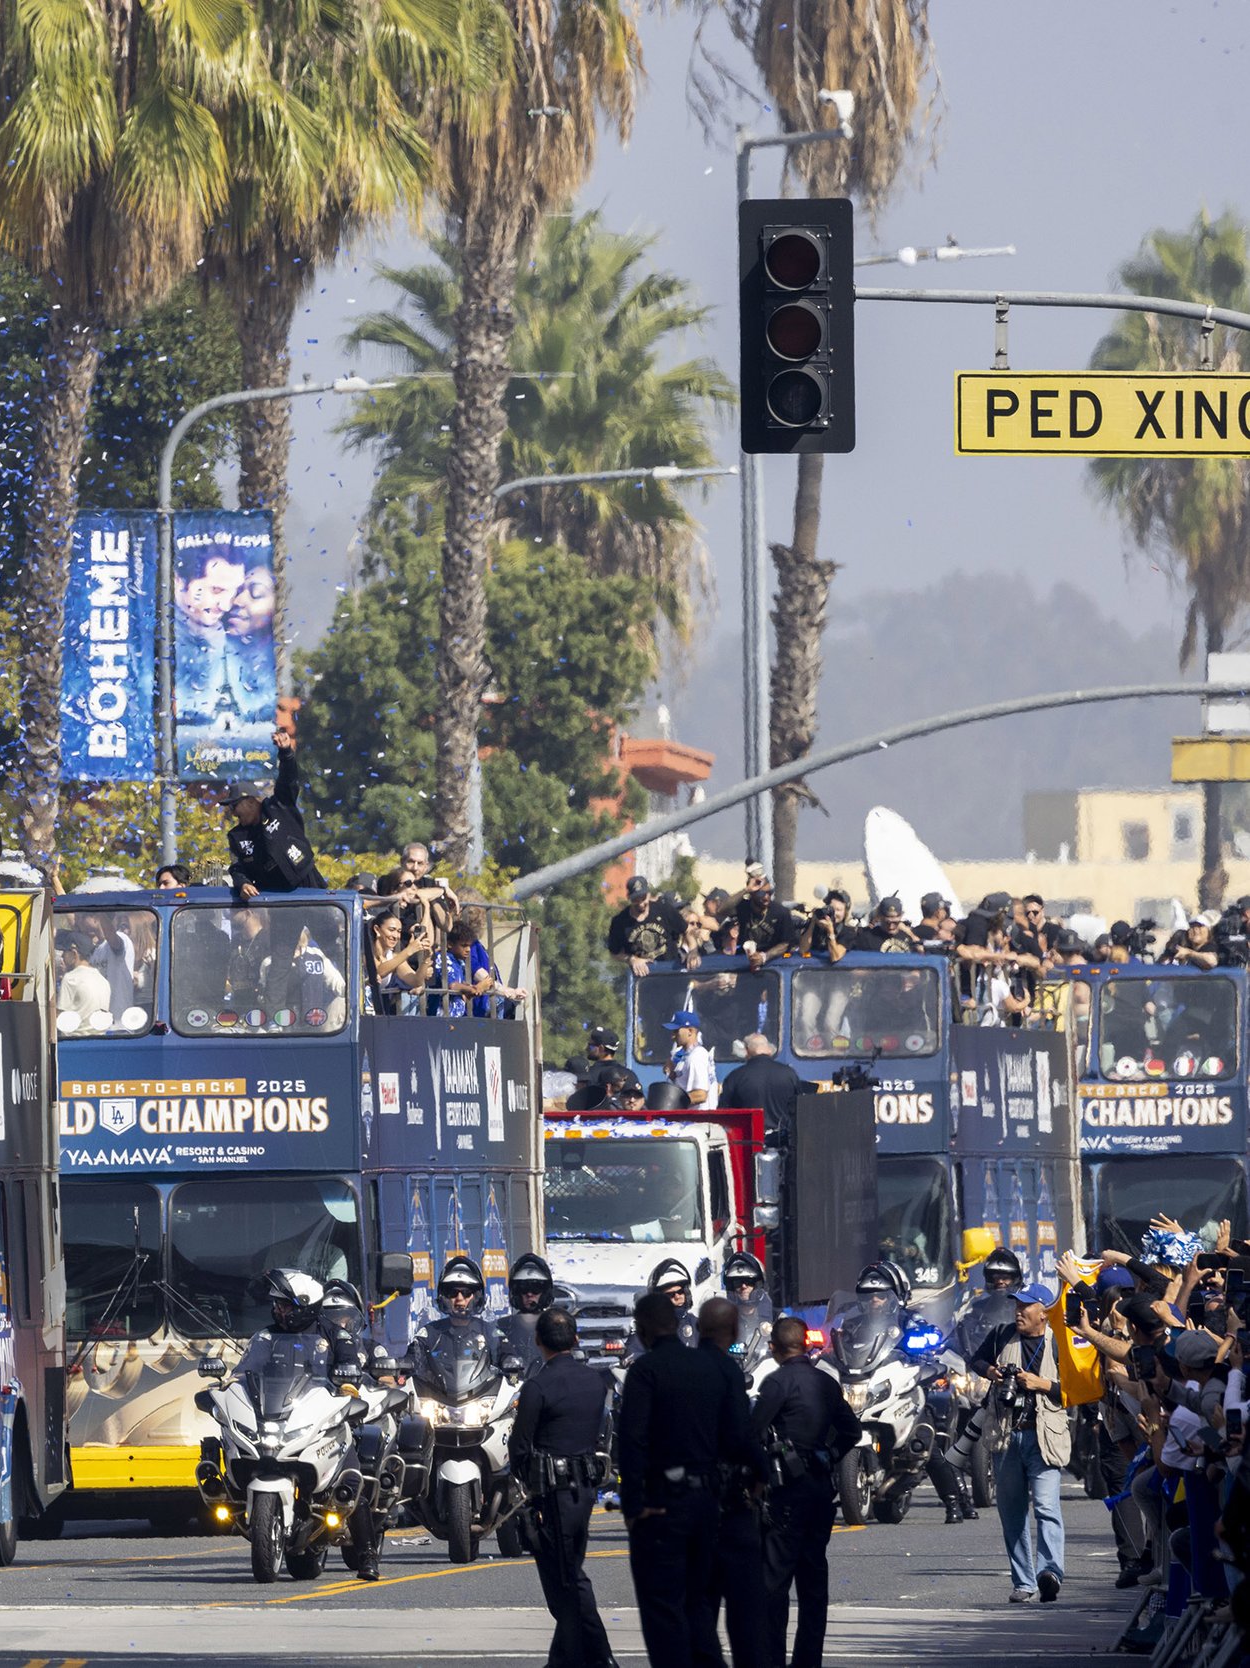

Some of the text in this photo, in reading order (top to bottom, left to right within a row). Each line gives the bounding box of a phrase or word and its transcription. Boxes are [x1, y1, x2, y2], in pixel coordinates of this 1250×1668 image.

[986, 388, 1103, 438] PED
[177, 533, 213, 551] FALL
[233, 533, 271, 548] LOVE
[79, 530, 130, 758] BOHÈME
[305, 960, 323, 975] 30
[72, 1080, 306, 1095] BACK-TO-BACK 2025
[140, 1097, 330, 1134] CHAMPIONS
[1085, 1096, 1234, 1127] CHAMPIONS
[175, 1147, 214, 1156] RESORT
[227, 1146, 265, 1155] CASINO
[914, 1267, 939, 1283] 345
